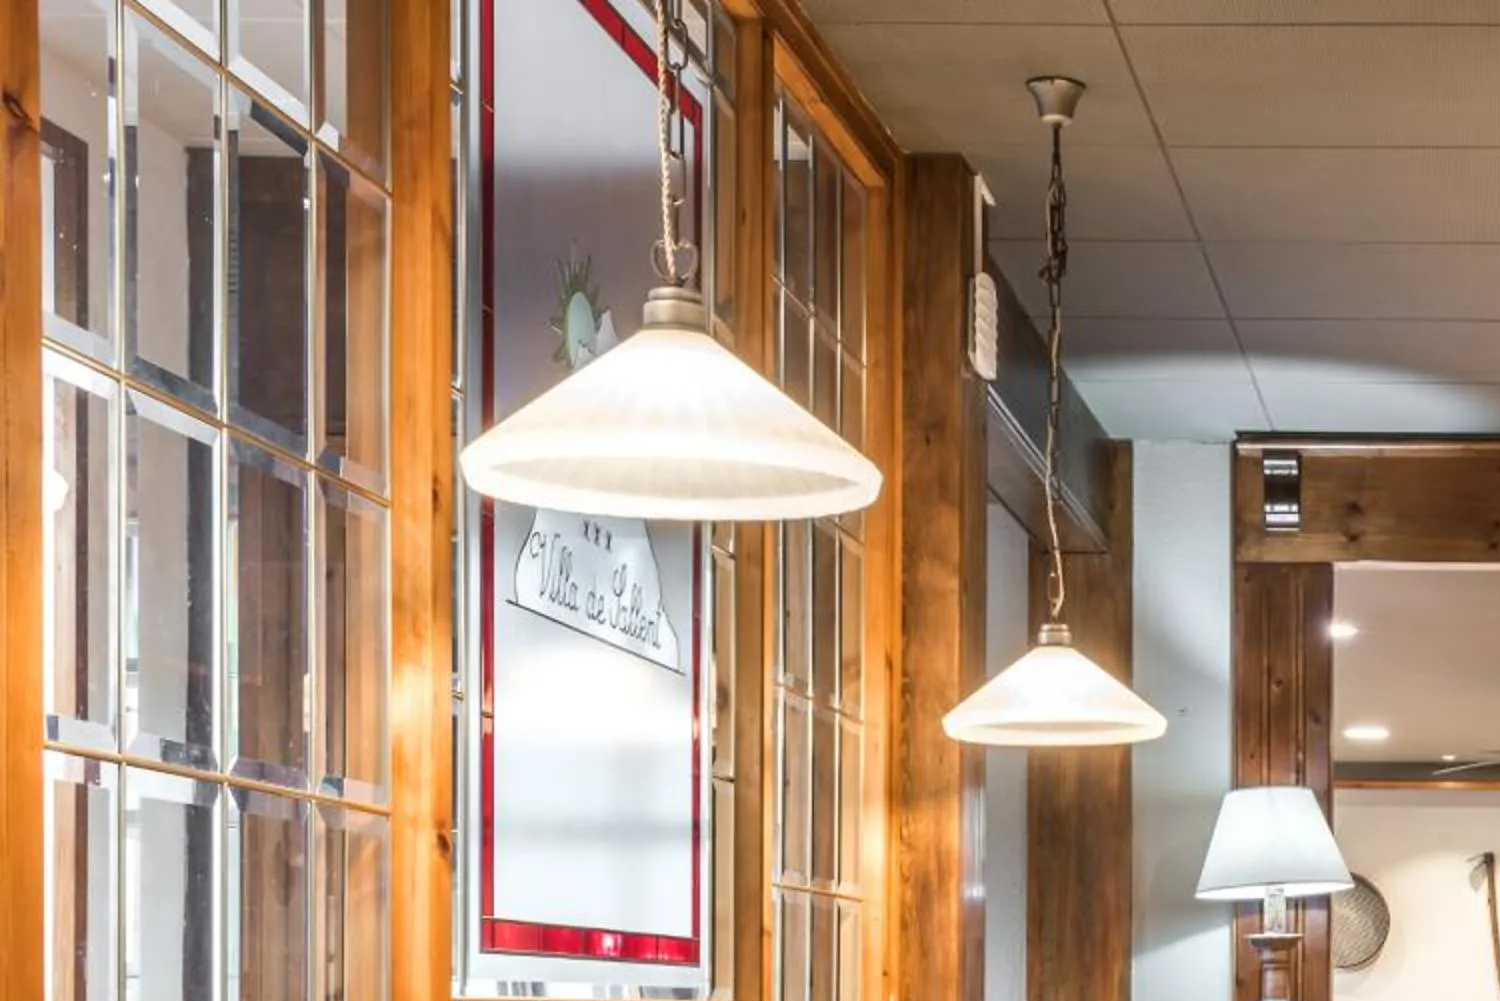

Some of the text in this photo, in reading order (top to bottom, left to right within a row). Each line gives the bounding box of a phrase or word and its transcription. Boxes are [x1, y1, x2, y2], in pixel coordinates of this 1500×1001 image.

[530, 531, 662, 649] Villa de Sallent
